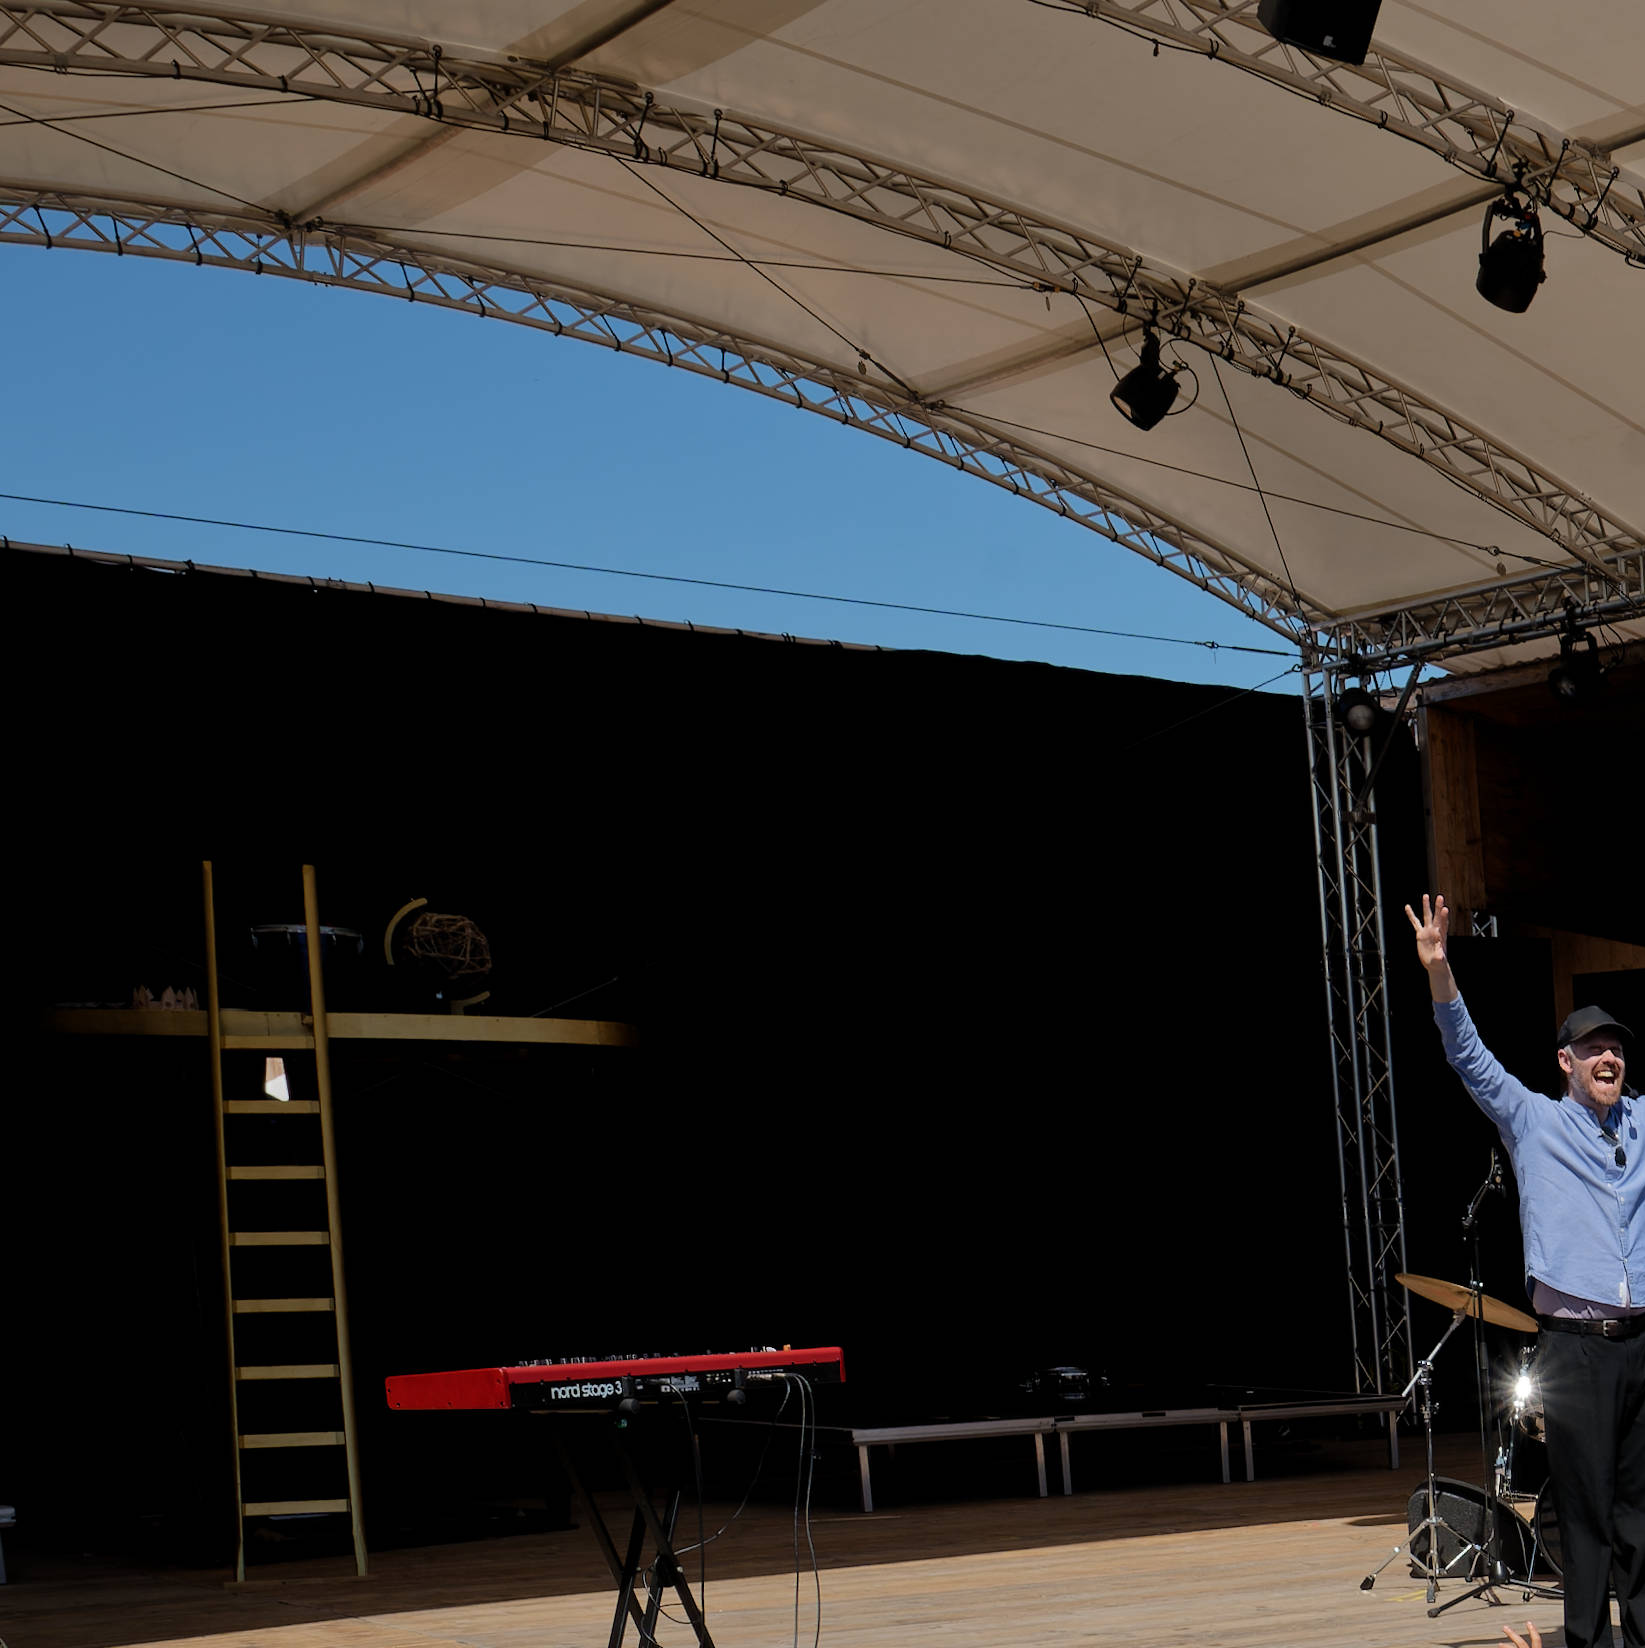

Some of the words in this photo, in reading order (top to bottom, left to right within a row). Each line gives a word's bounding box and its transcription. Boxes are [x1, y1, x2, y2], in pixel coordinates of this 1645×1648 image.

[550, 1383, 581, 1400] nord
[581, 1382, 615, 1398] stage
[615, 1380, 623, 1395] 3
